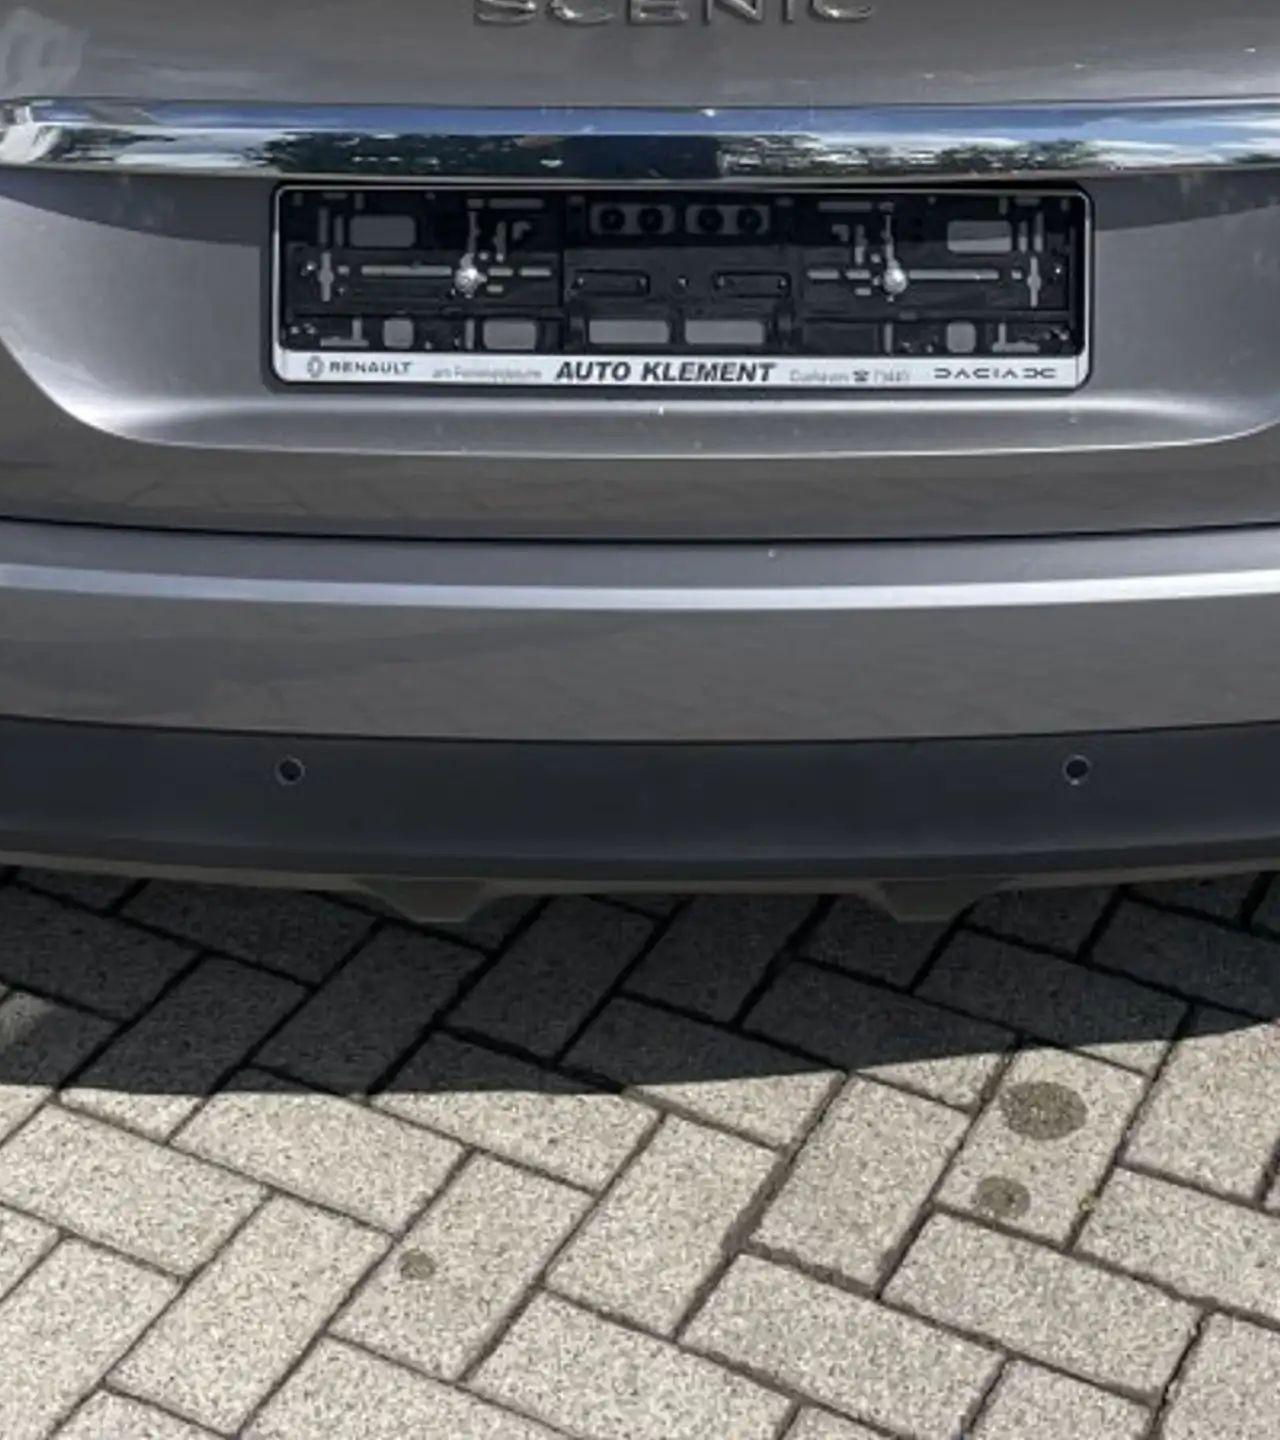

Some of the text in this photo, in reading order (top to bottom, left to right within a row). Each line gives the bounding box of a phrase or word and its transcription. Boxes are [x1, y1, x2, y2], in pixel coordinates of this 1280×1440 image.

[329, 360, 411, 376] RENAULT
[556, 361, 631, 381] AUTO
[640, 362, 777, 383] KLEMENT
